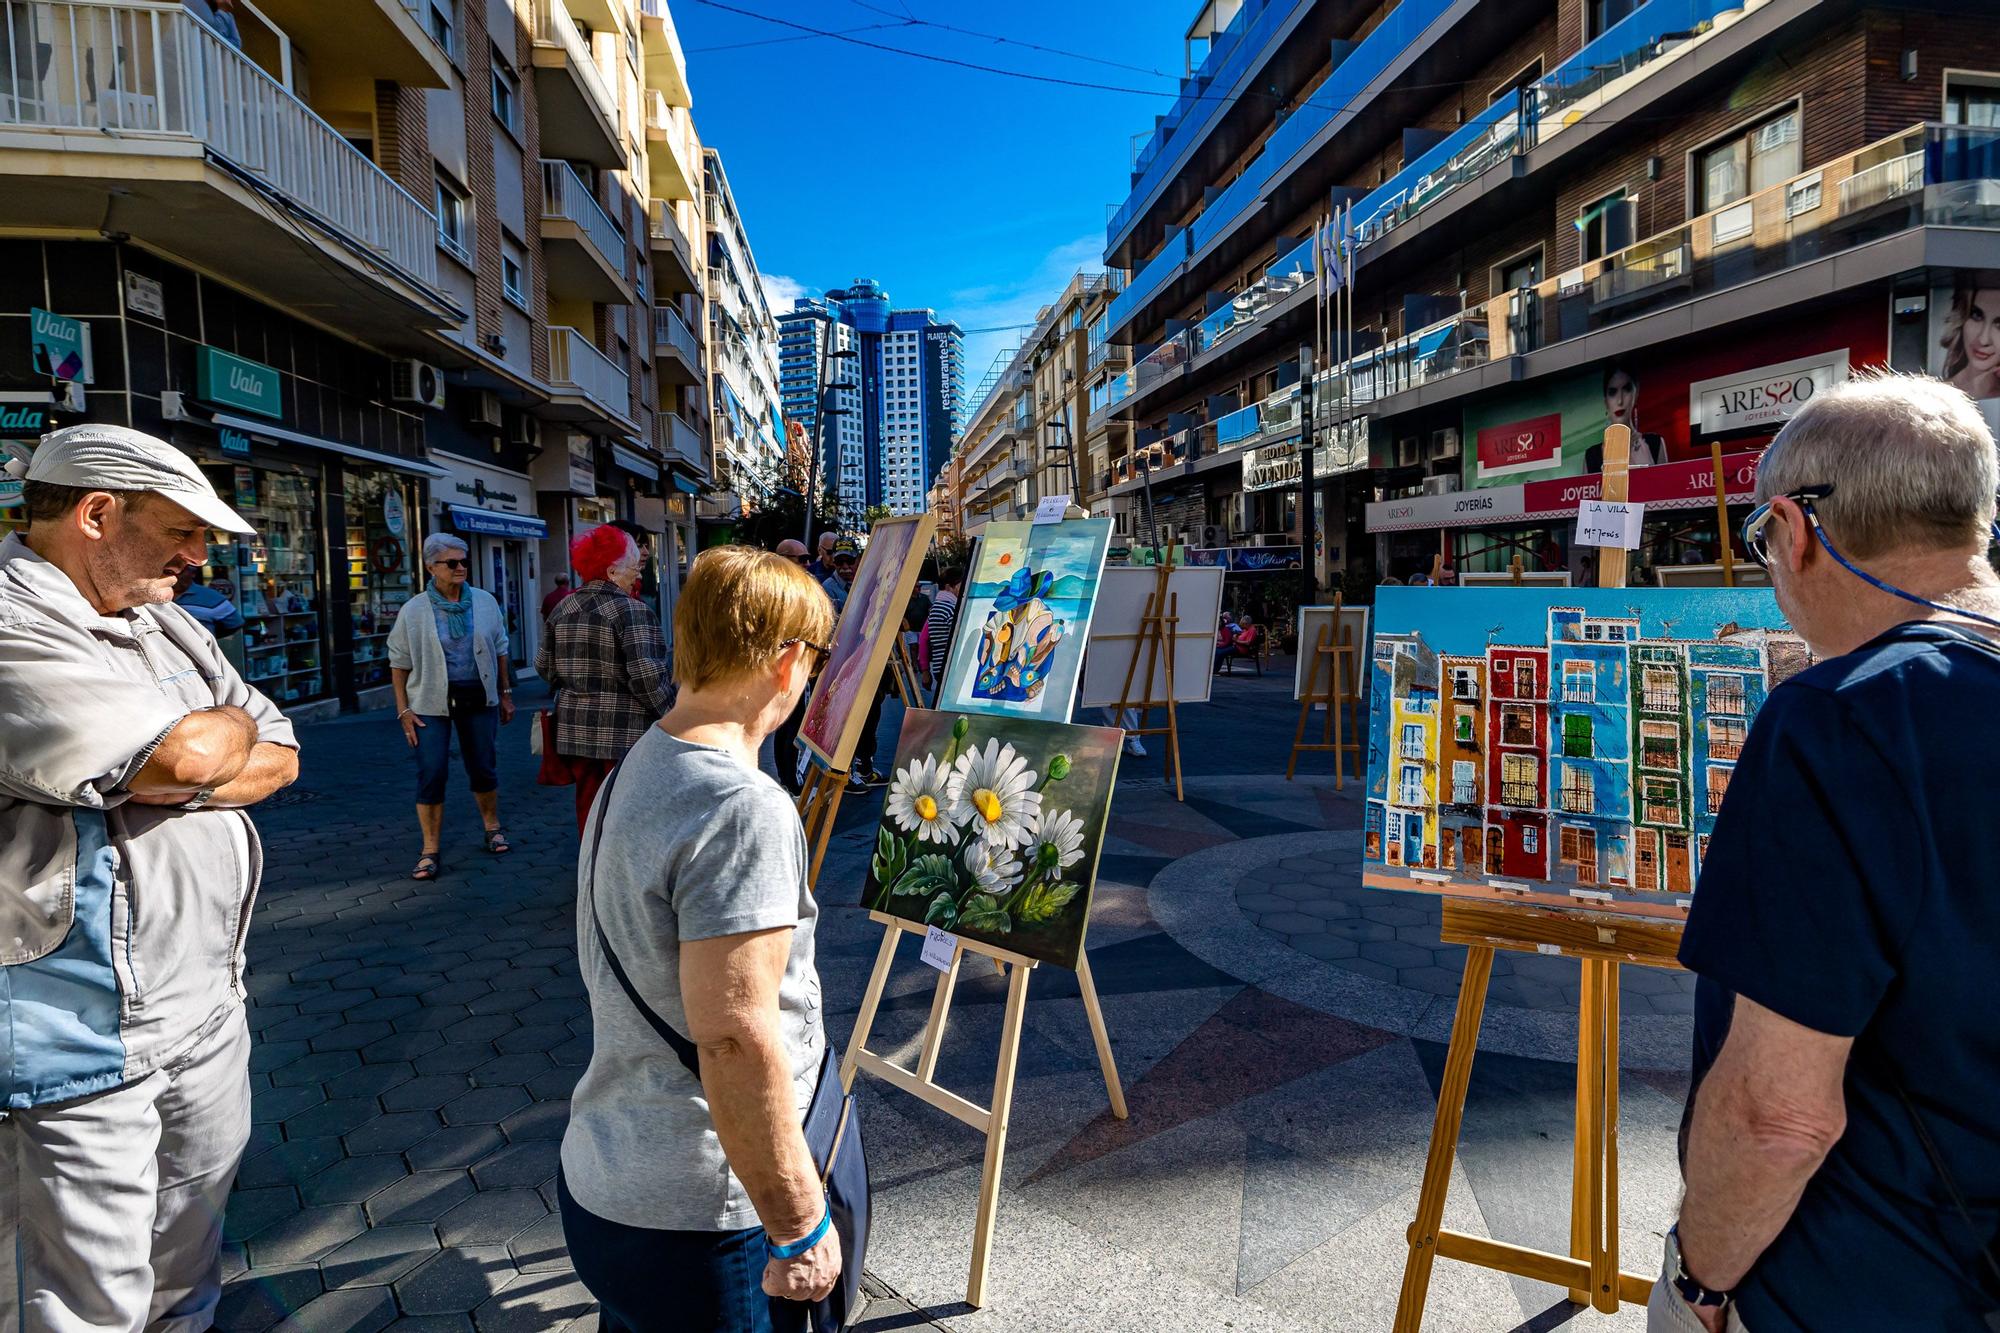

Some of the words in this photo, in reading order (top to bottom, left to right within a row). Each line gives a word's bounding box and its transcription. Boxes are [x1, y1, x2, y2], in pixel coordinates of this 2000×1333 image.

[36, 312, 76, 342] Uala
[927, 333, 947, 341] PLANTA
[230, 366, 263, 396] Uala
[940, 348, 950, 410] restaurante
[221, 428, 249, 453] Uala
[1560, 481, 1603, 501] JOYERÍ
[1454, 496, 1493, 513] JOYERÍAS
[1589, 503, 1602, 513] LA
[1607, 505, 1630, 514] VILA
